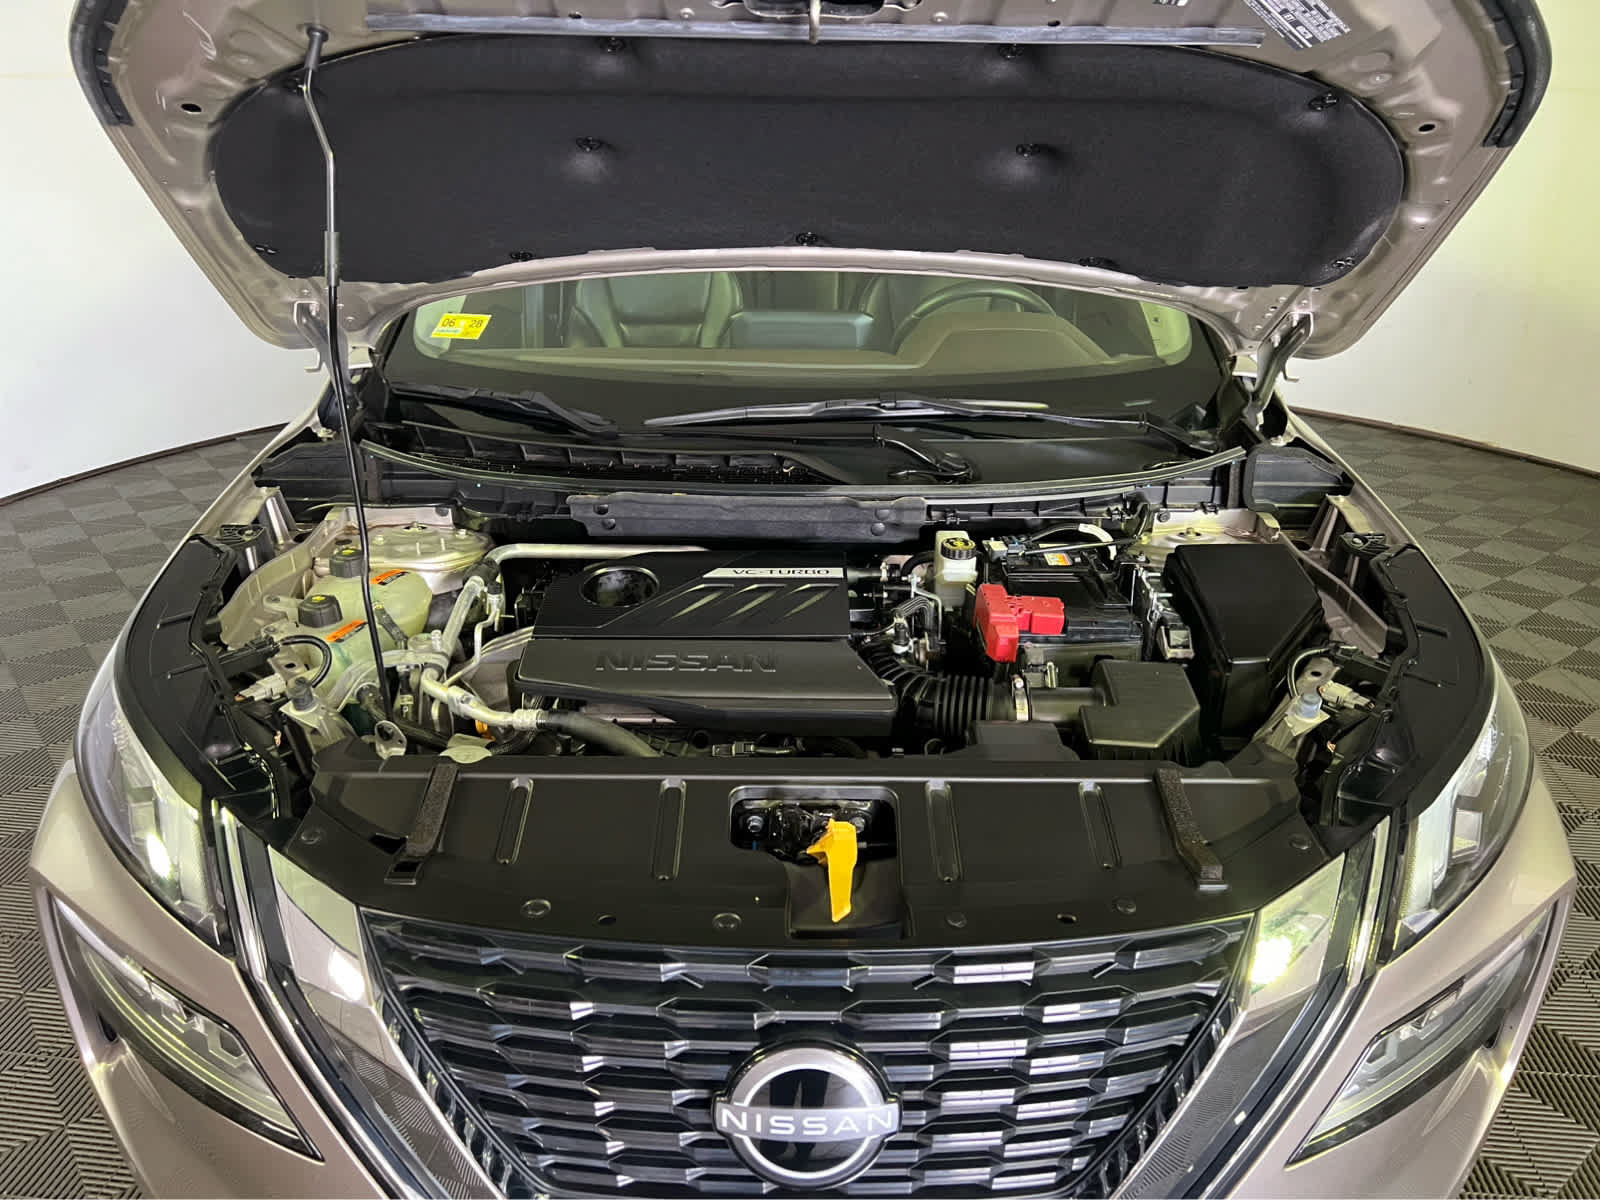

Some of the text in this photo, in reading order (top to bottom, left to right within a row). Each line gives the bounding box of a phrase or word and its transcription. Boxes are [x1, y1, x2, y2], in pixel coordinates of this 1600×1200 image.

[441, 318, 484, 329] 06 28
[594, 652, 778, 673] NISSAN
[721, 1108, 892, 1135] NISSAN
